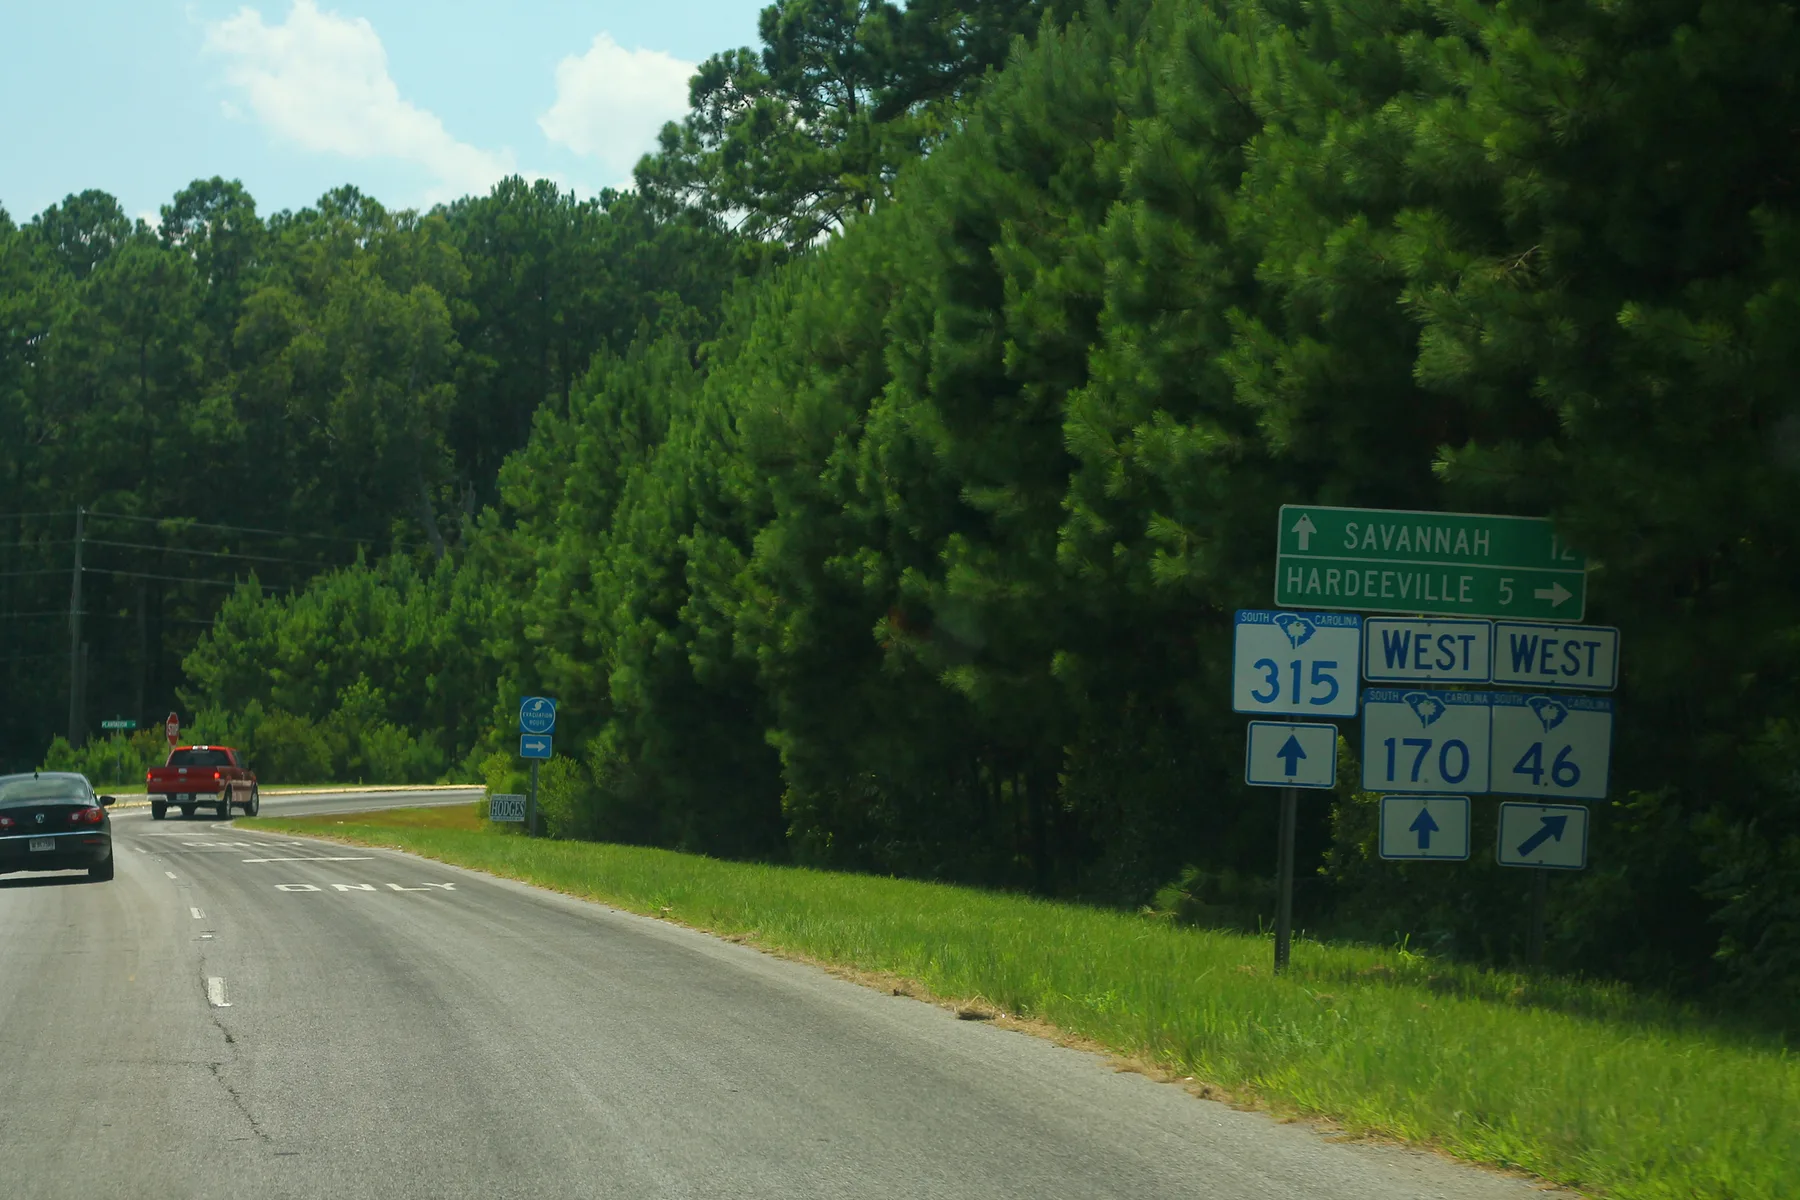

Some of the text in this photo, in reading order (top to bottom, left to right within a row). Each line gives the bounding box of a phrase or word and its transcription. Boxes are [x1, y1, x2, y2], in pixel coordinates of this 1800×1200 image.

[1344, 522, 1490, 556] SAVANNAH
[1287, 566, 1515, 605] HARDEEVILLE 5
[1241, 611, 1358, 627] SOUTH CAROLINA
[1382, 629, 1476, 672] WEST
[1510, 633, 1601, 678] WEST
[1250, 657, 1340, 706] 315
[1369, 690, 1489, 705] SOUTH CAROLINA
[1493, 694, 1611, 711] SOUTH CAROLINA
[168, 724, 179, 736] STOP
[1383, 737, 1470, 785] 170
[1512, 742, 1582, 788] 46
[491, 800, 524, 816] HODGES
[274, 882, 457, 893] ONLY
